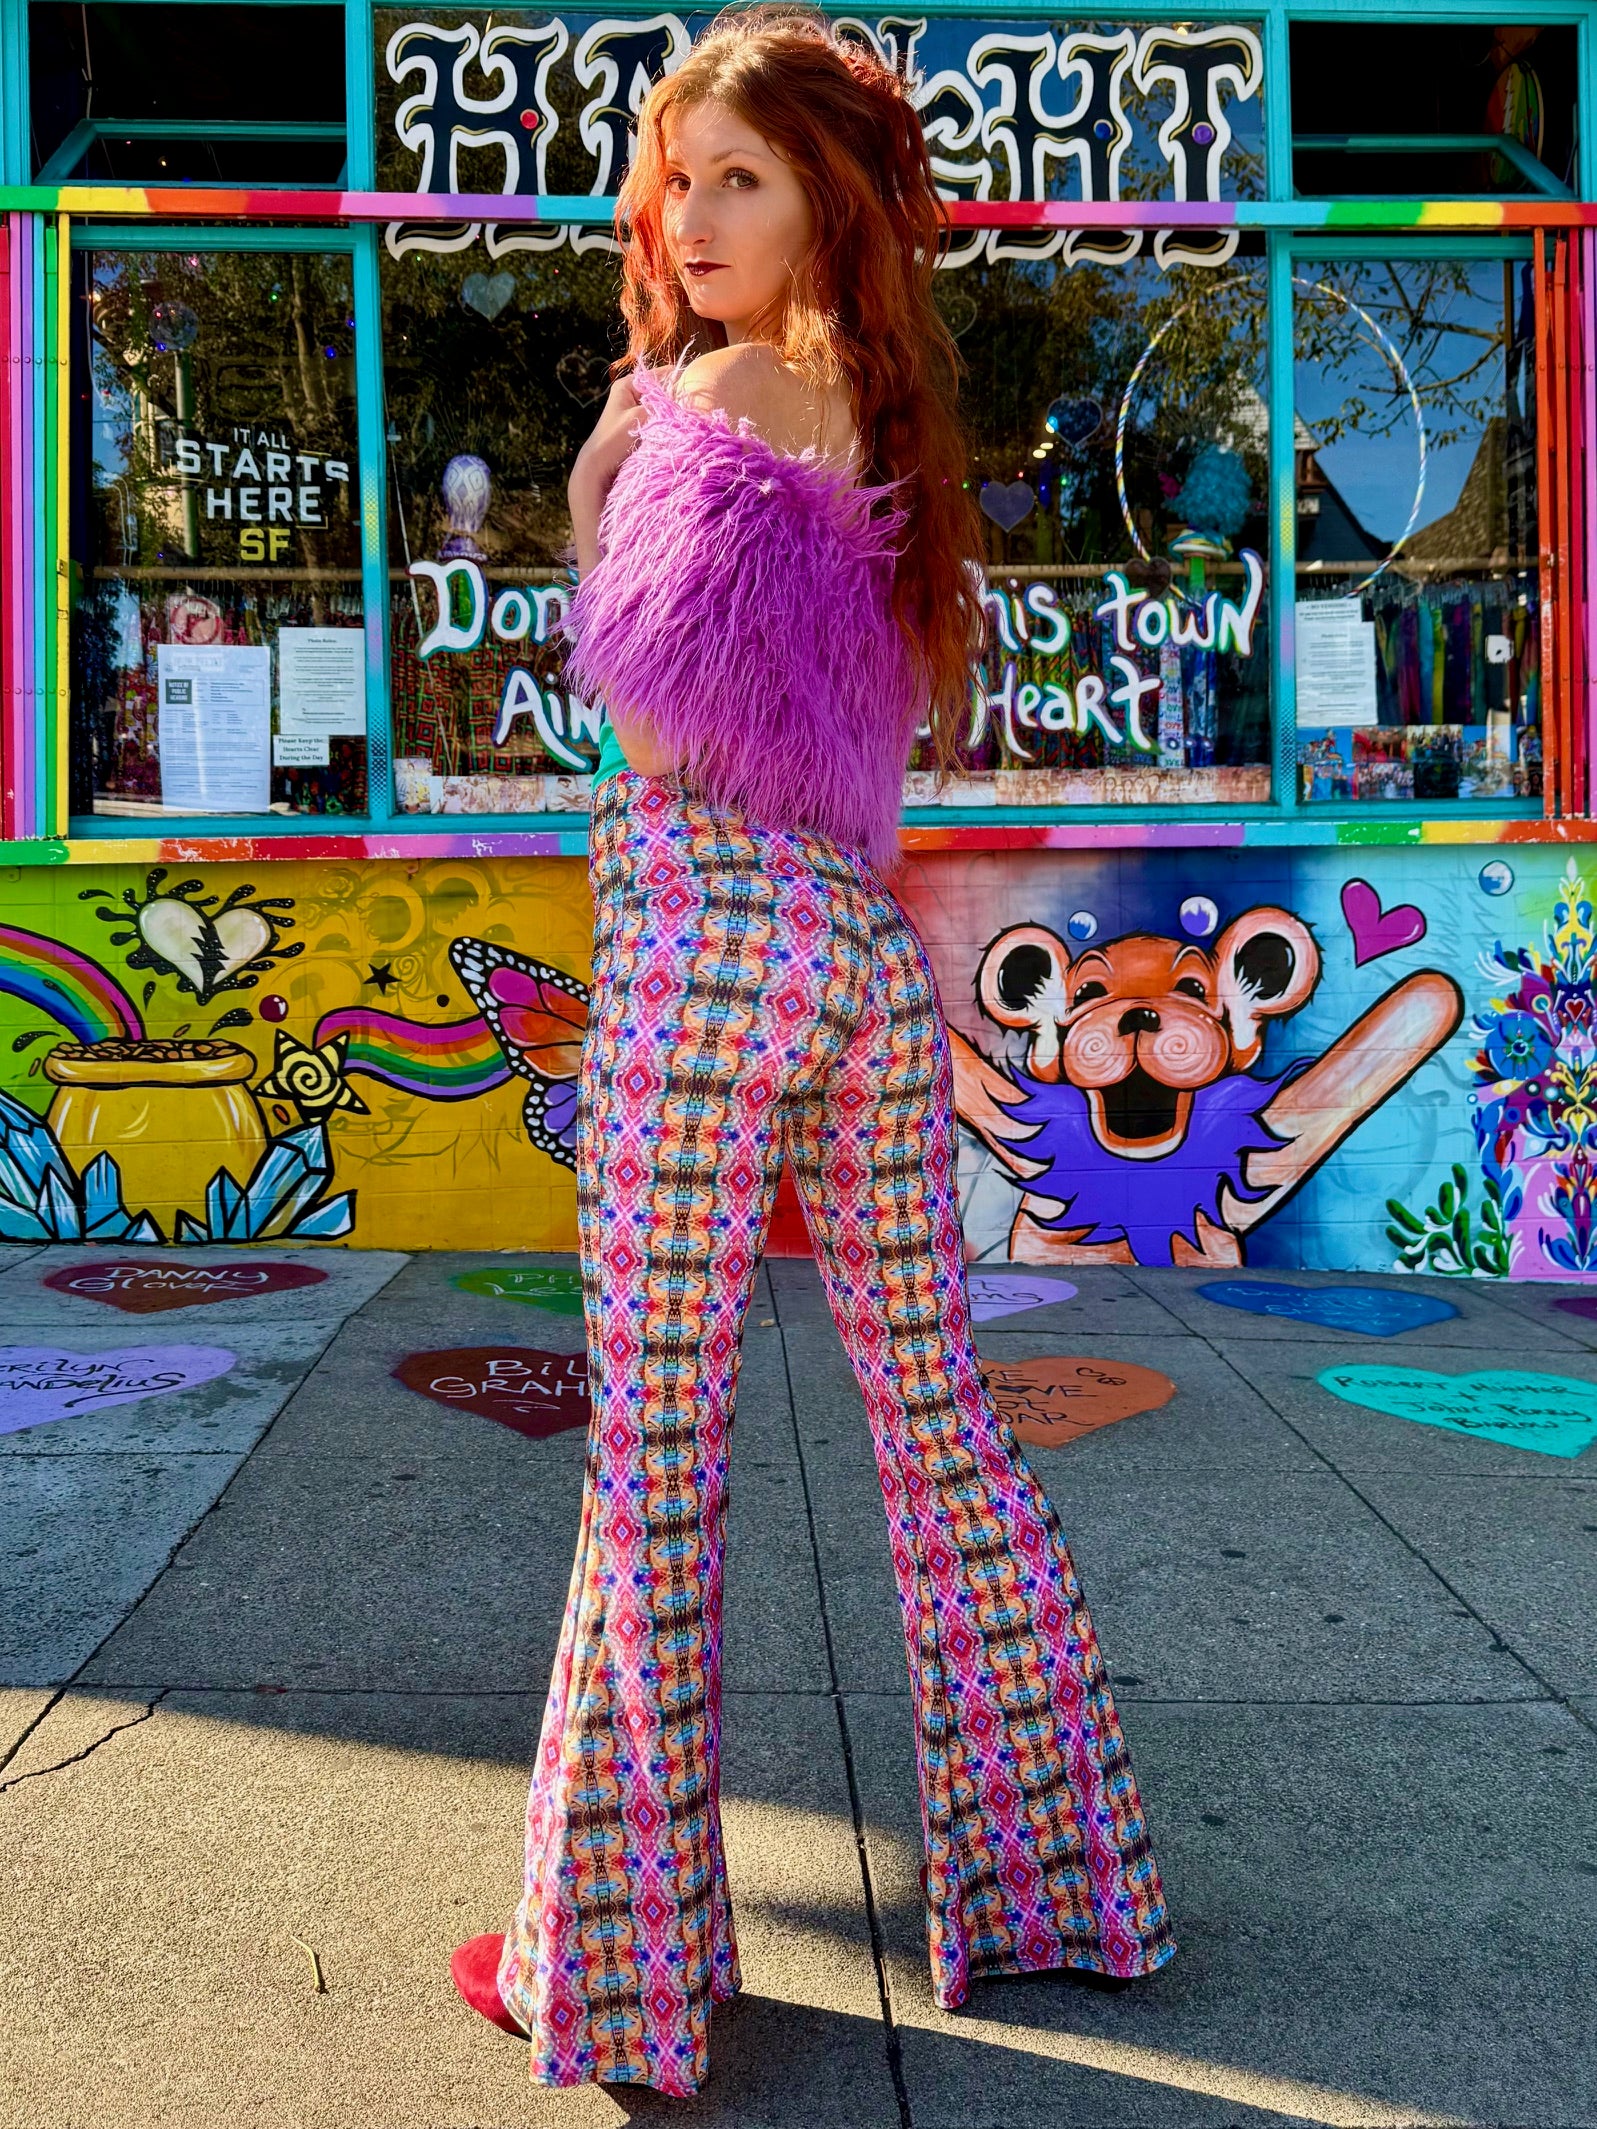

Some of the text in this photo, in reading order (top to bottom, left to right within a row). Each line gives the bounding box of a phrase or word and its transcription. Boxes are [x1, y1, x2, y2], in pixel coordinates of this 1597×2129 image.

[385, 16, 1264, 271] HAGHT
[233, 427, 291, 450] IT ALL
[175, 439, 350, 482] STARTS
[206, 486, 322, 522] HERE
[240, 528, 291, 561] SF
[957, 559, 1071, 654] his
